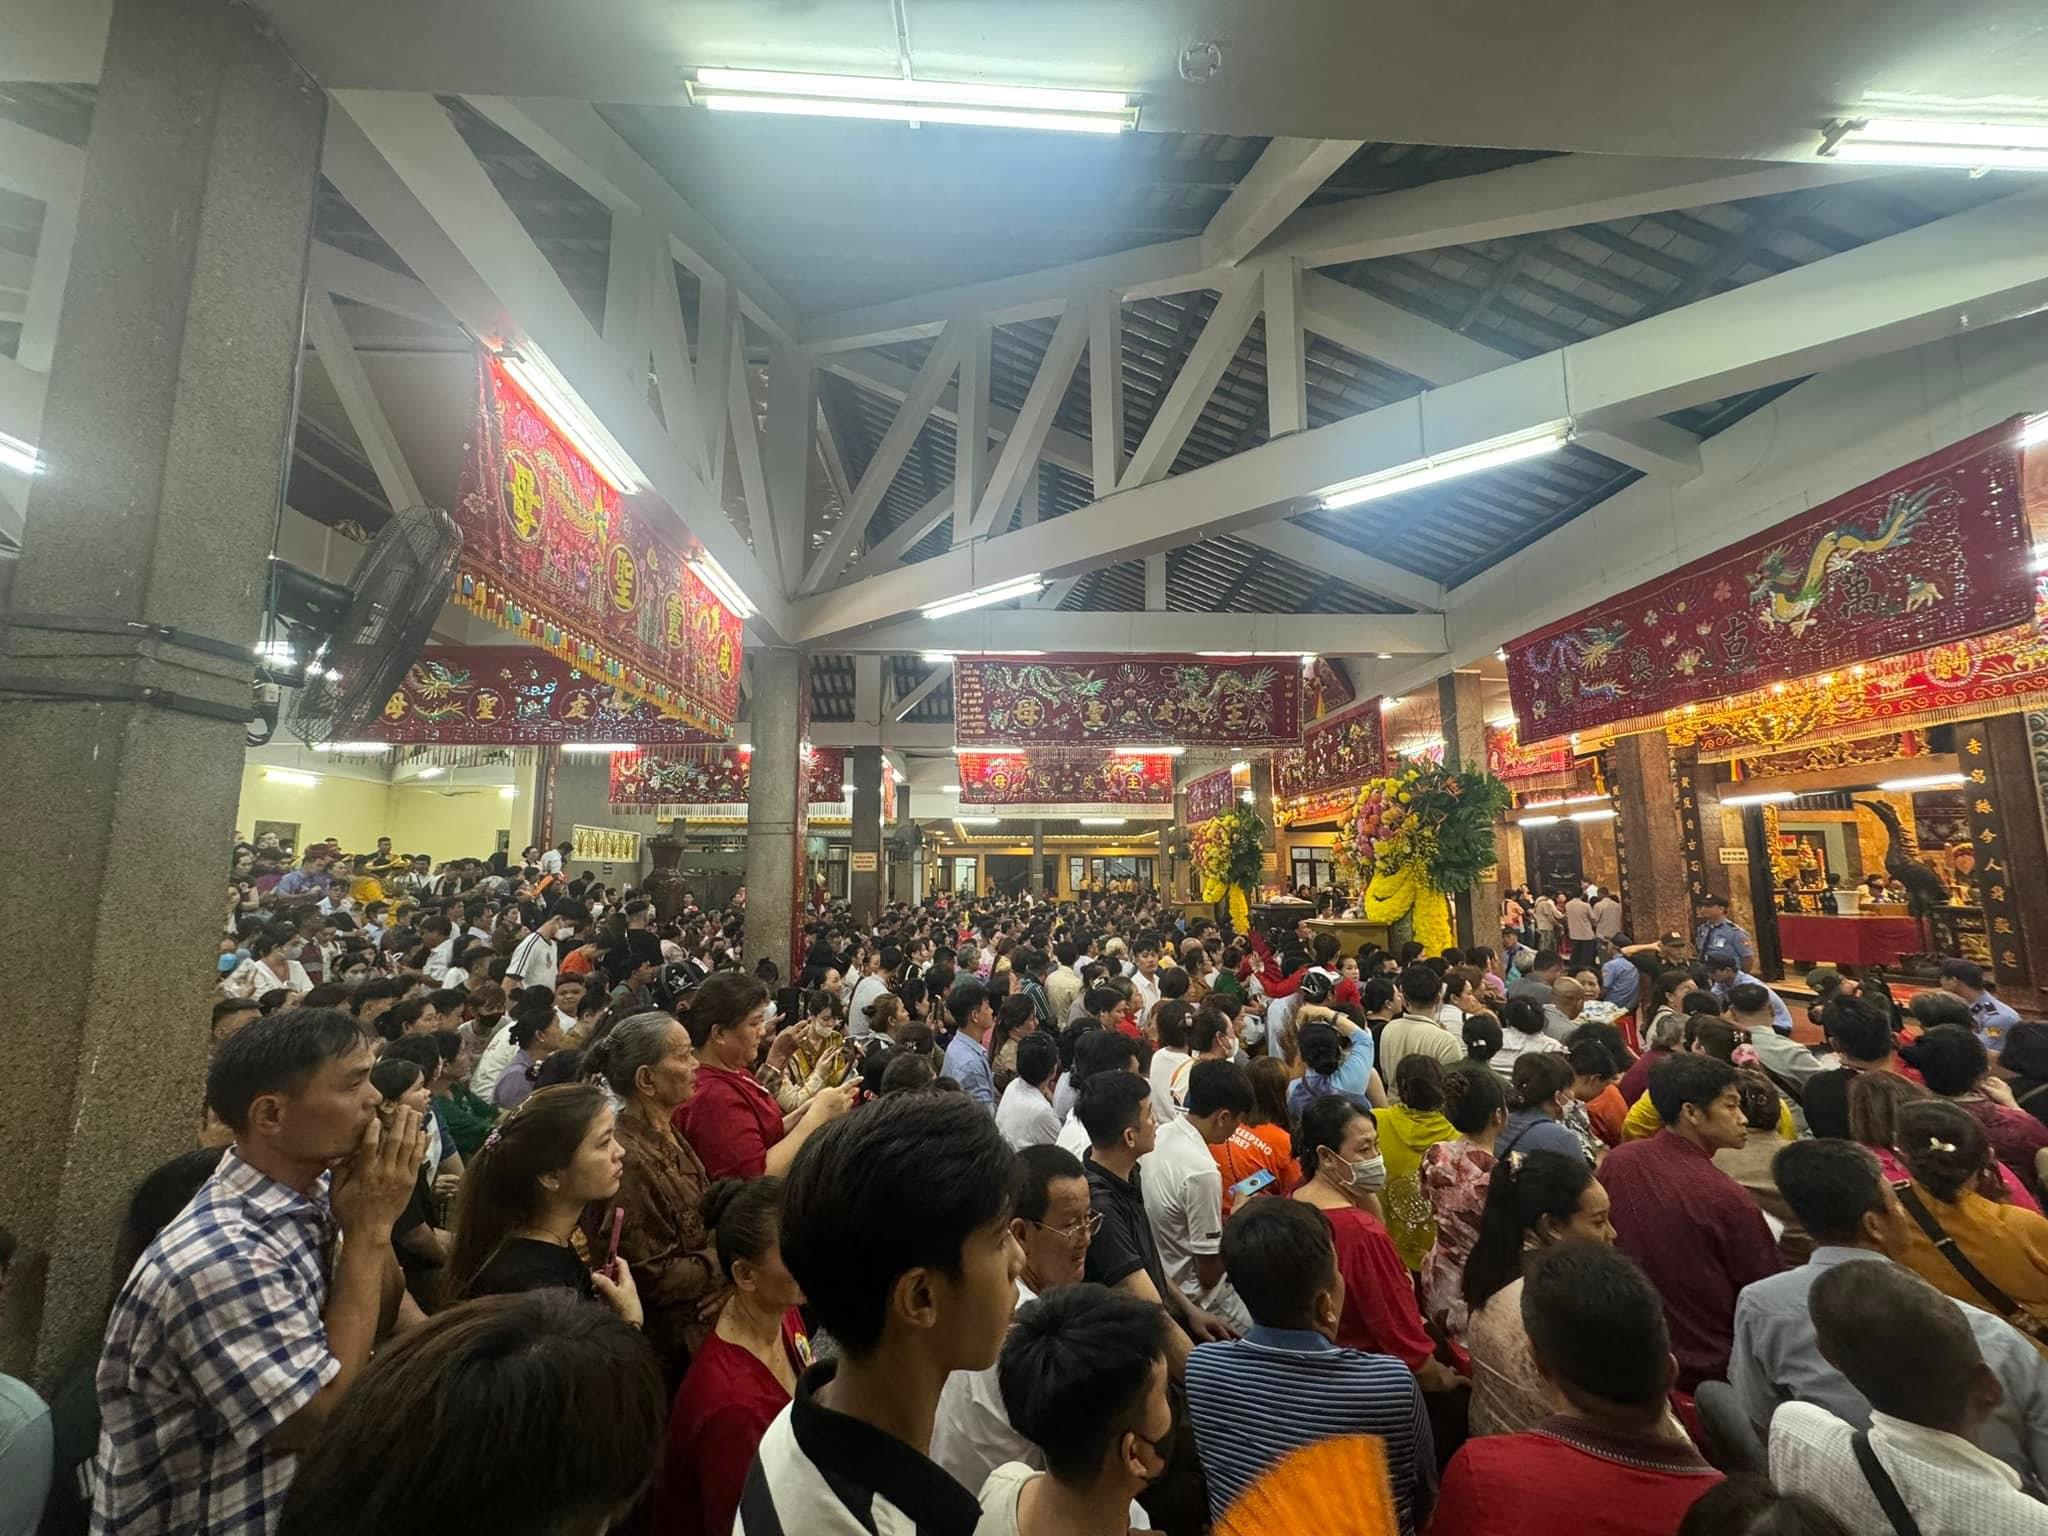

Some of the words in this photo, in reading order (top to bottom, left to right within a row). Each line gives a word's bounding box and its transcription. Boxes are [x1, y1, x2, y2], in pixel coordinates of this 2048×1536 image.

[503, 461, 542, 538] 母
[475, 693, 499, 720] 聖
[1012, 699, 1041, 728] 母
[1085, 699, 1107, 727] 聖
[1224, 697, 1247, 728] 主
[994, 774, 1007, 790] 母
